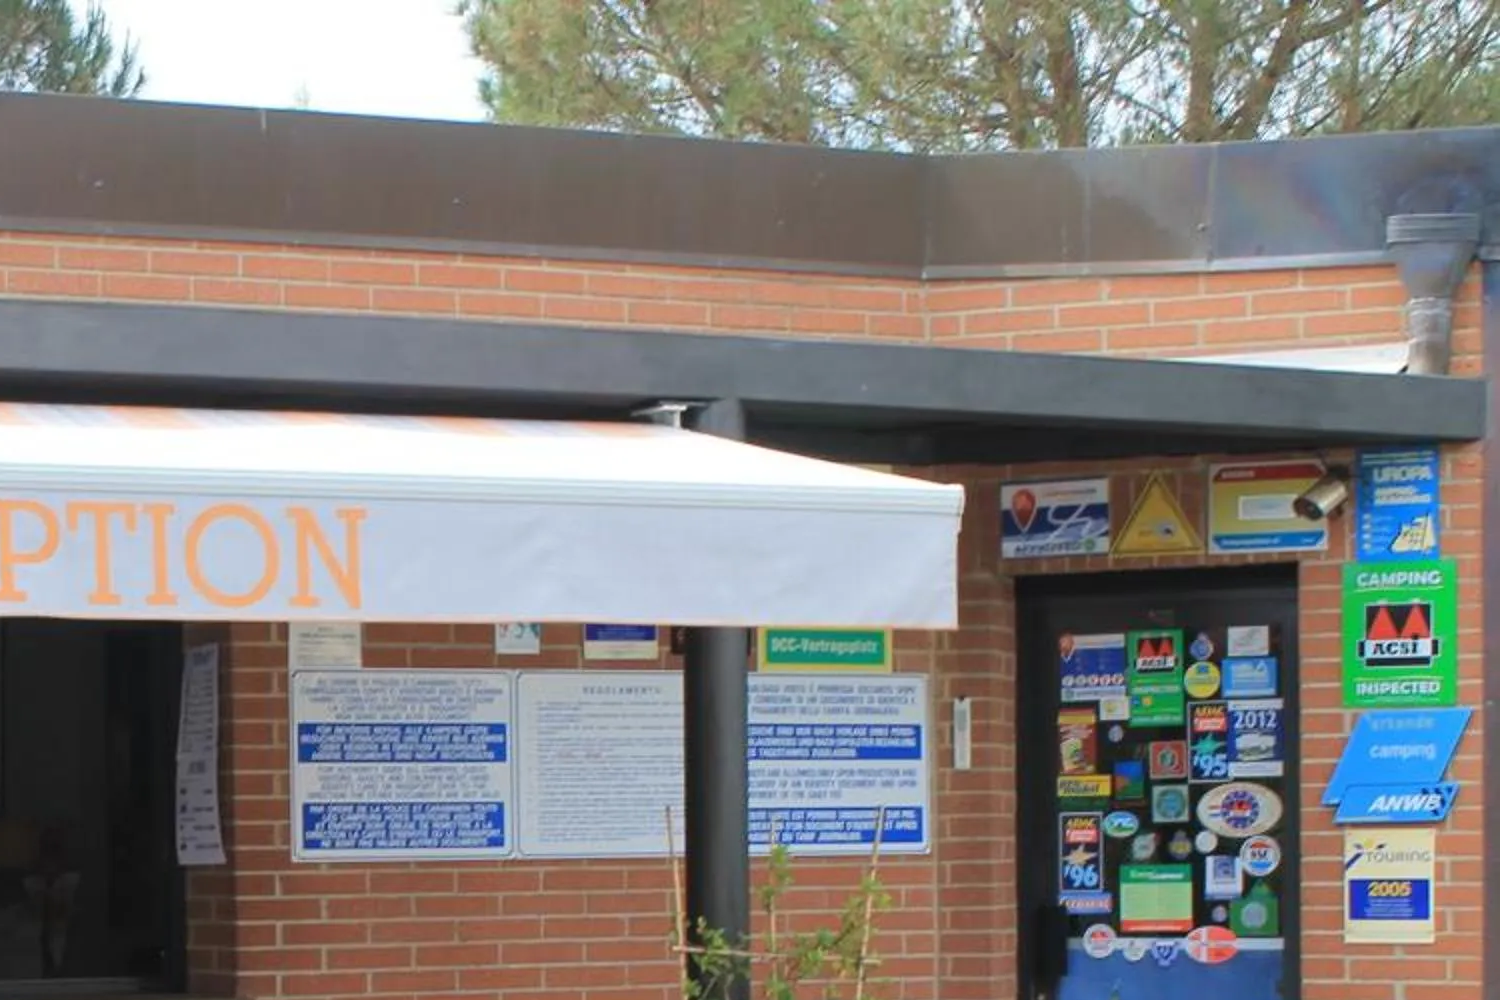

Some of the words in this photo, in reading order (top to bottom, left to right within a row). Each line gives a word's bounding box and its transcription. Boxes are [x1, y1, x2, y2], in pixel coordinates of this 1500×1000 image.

[1356, 570, 1442, 587] CAMPING
[1356, 681, 1441, 696] INSPECTED
[1234, 711, 1277, 729] 2012
[1369, 742, 1437, 760] camping
[1367, 794, 1444, 813] ANWB
[1365, 850, 1432, 864] TOURING
[1063, 863, 1099, 888] '96
